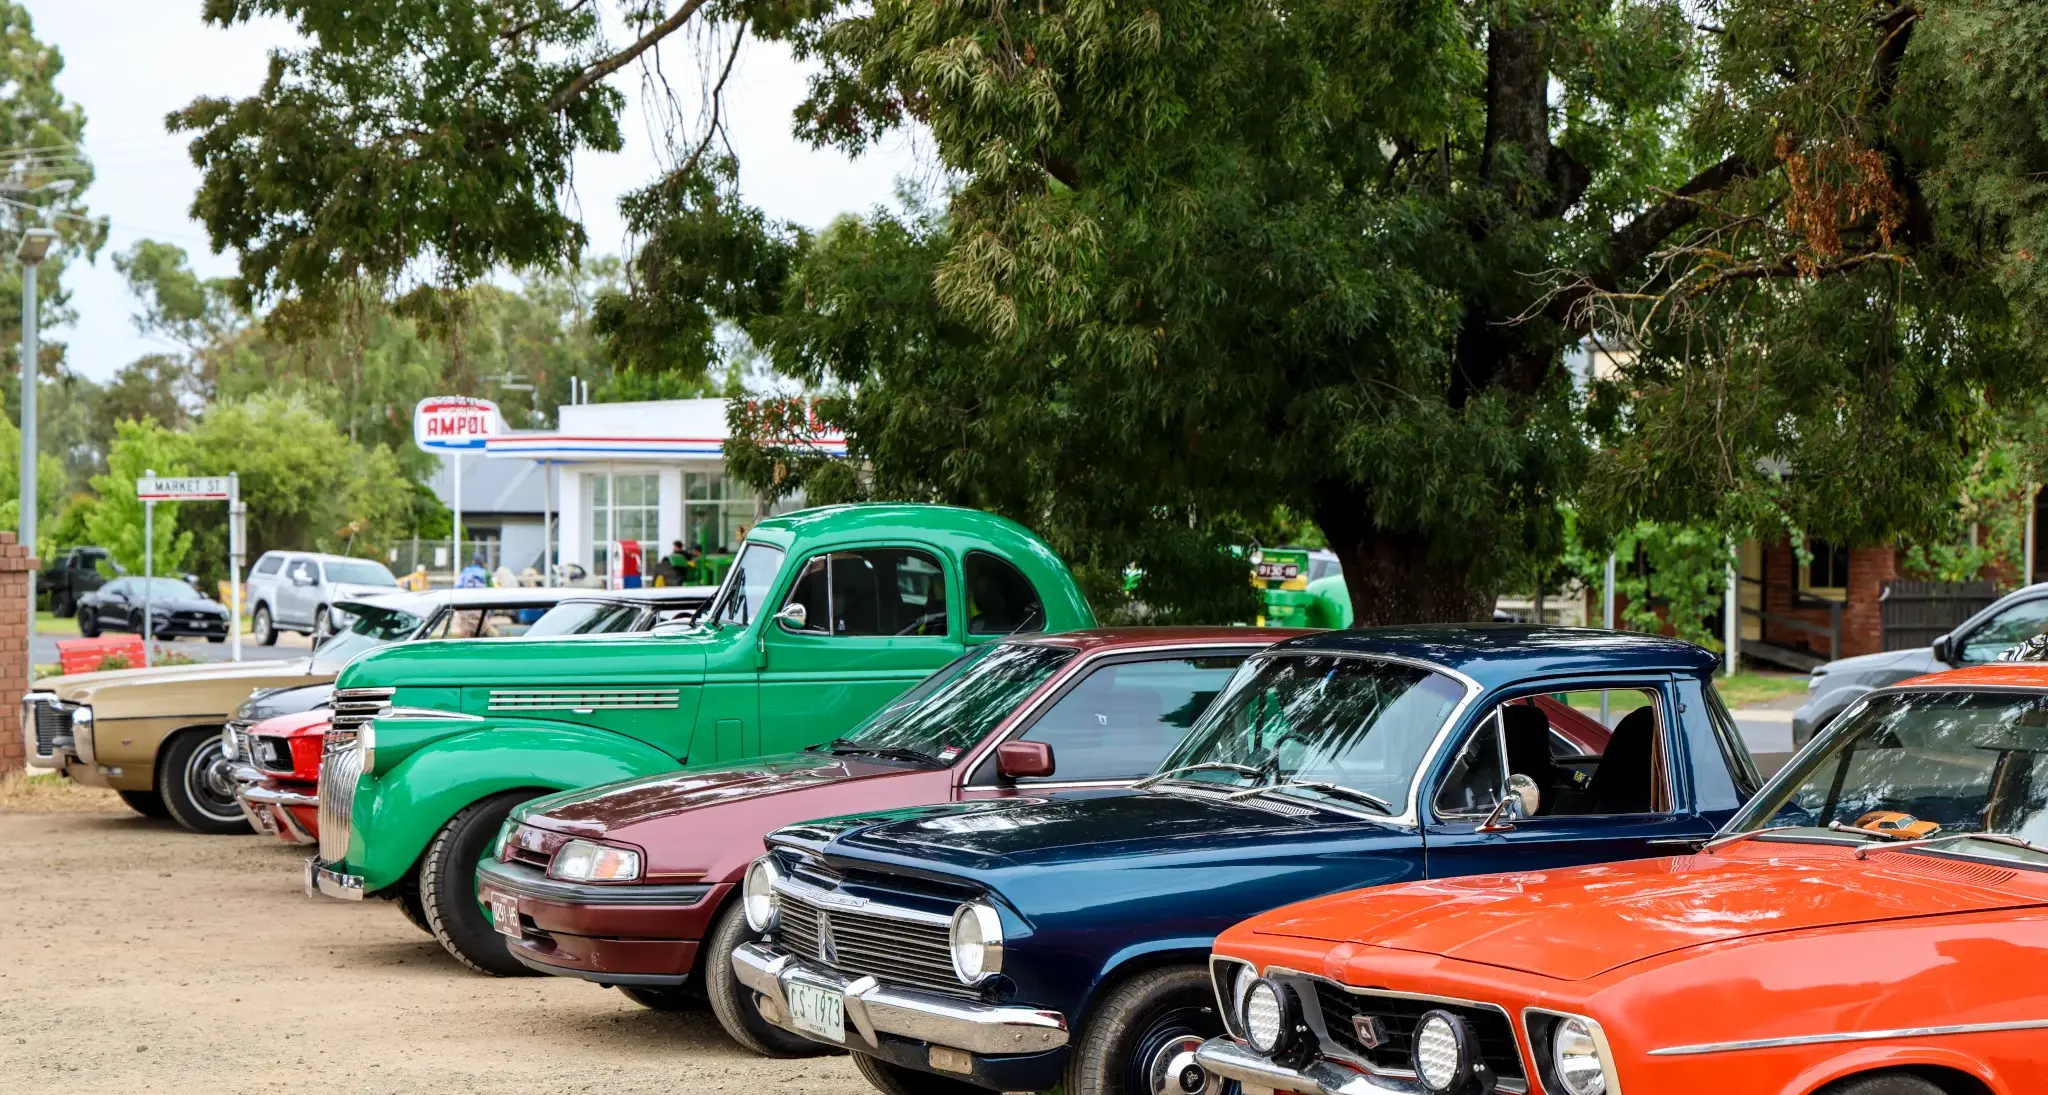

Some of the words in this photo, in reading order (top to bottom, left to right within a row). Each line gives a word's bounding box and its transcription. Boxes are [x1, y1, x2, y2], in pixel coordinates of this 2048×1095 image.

[427, 416, 489, 437] AMPOL
[155, 480, 200, 492] MARKET
[207, 480, 221, 492] ST
